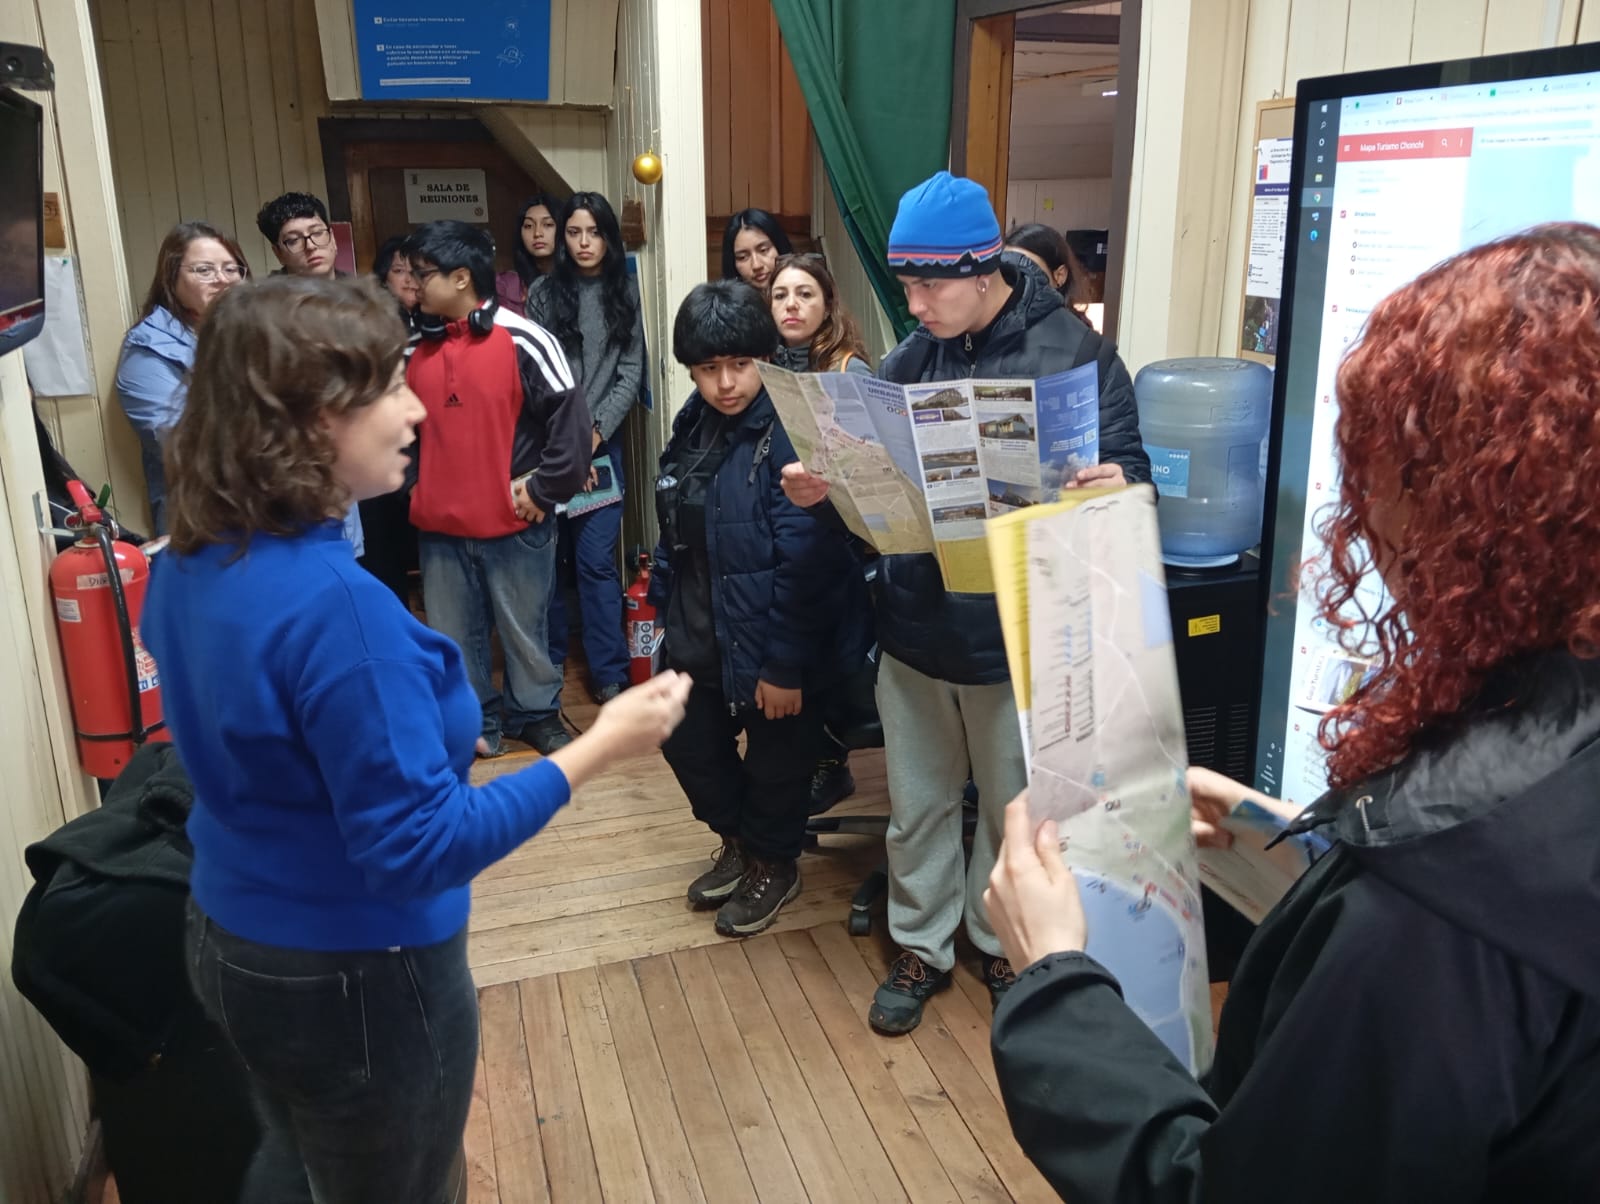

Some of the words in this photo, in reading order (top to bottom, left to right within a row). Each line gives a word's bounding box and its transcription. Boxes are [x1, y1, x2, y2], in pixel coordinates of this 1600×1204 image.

[1360, 143, 1376, 152] Mapa
[1377, 142, 1399, 151] Turismo
[1400, 140, 1424, 150] Chonchi
[427, 183, 453, 192] SALA
[456, 183, 470, 192] DE
[420, 194, 478, 203] REUNIONES
